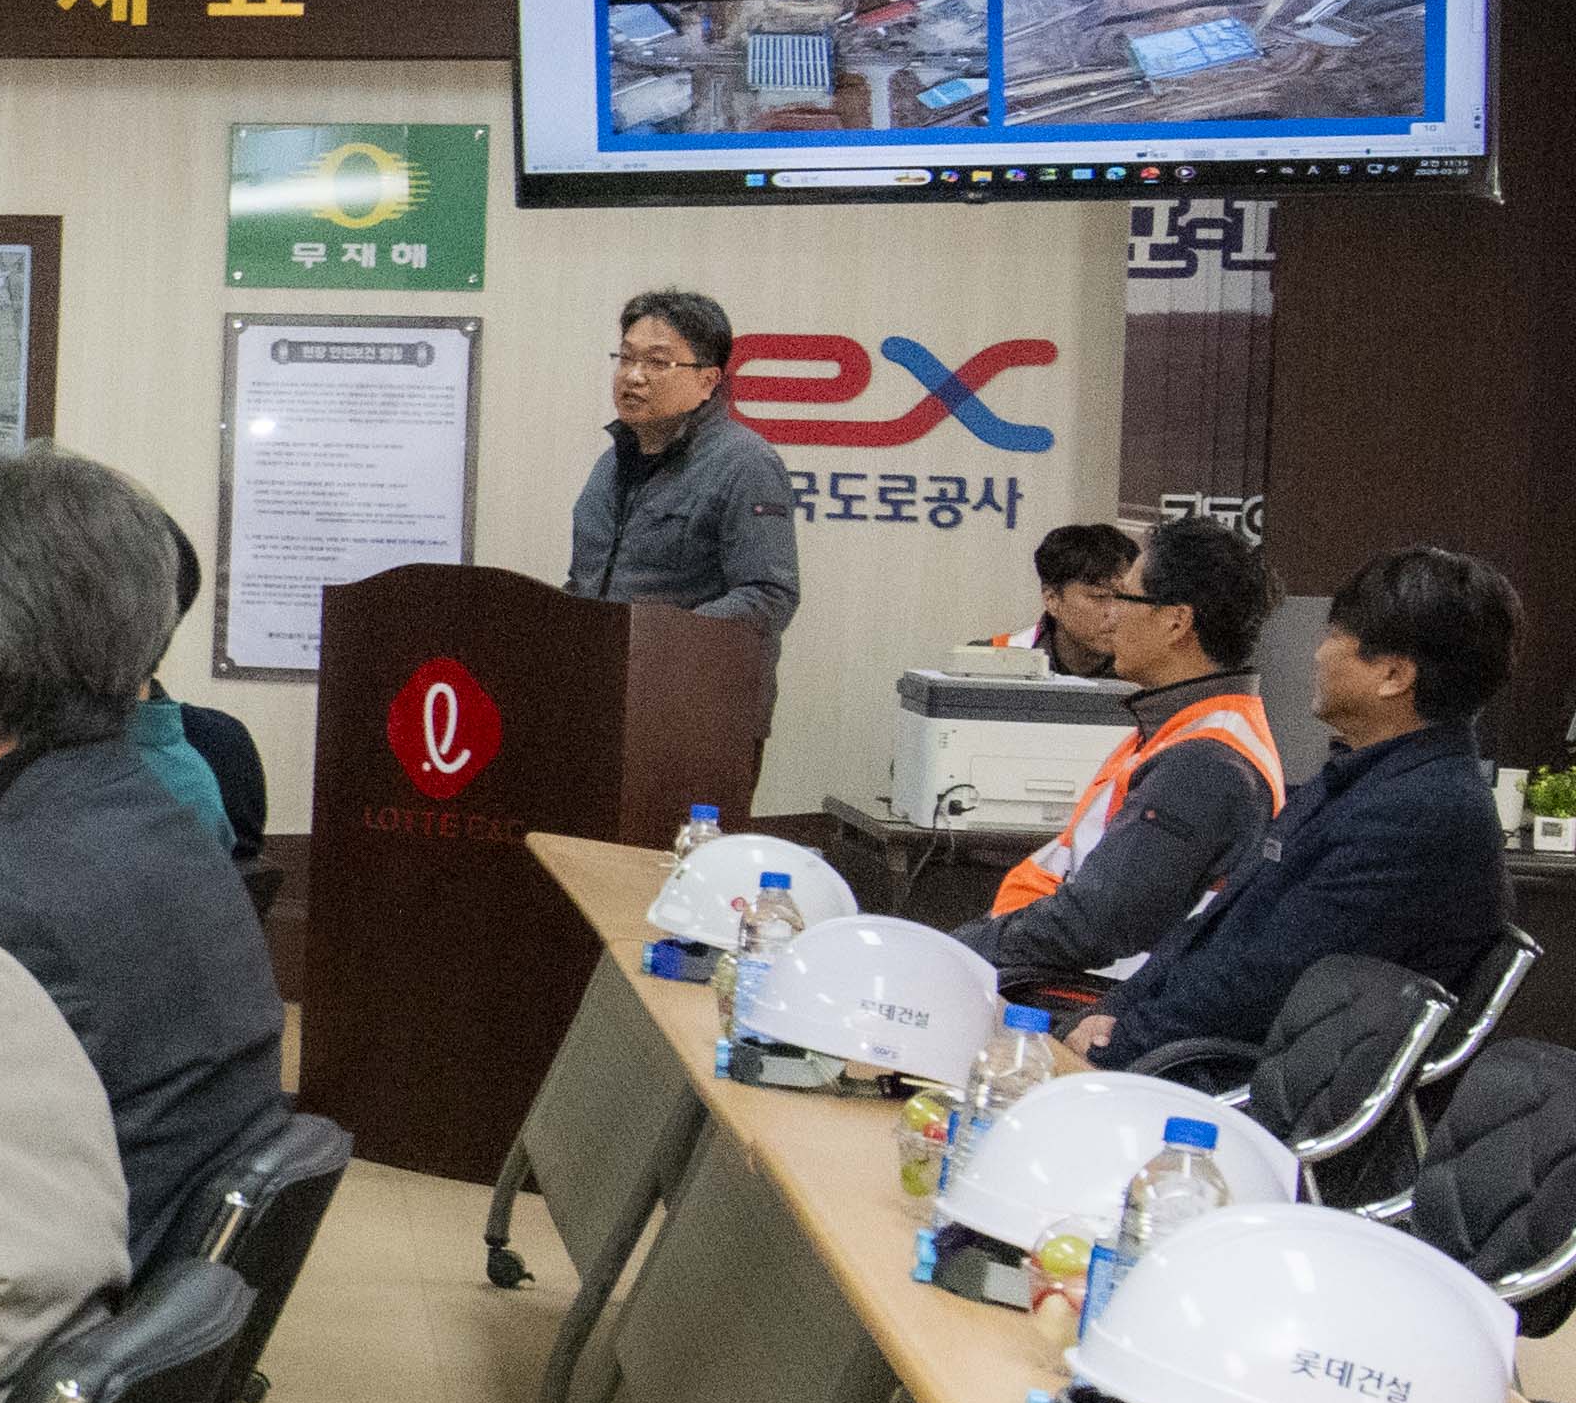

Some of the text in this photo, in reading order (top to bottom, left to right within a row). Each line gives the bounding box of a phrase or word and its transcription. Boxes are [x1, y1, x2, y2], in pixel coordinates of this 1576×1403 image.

[290, 241, 429, 271] 무재해
[786, 471, 1024, 530] 국도로공사
[363, 805, 458, 839] LOTTE
